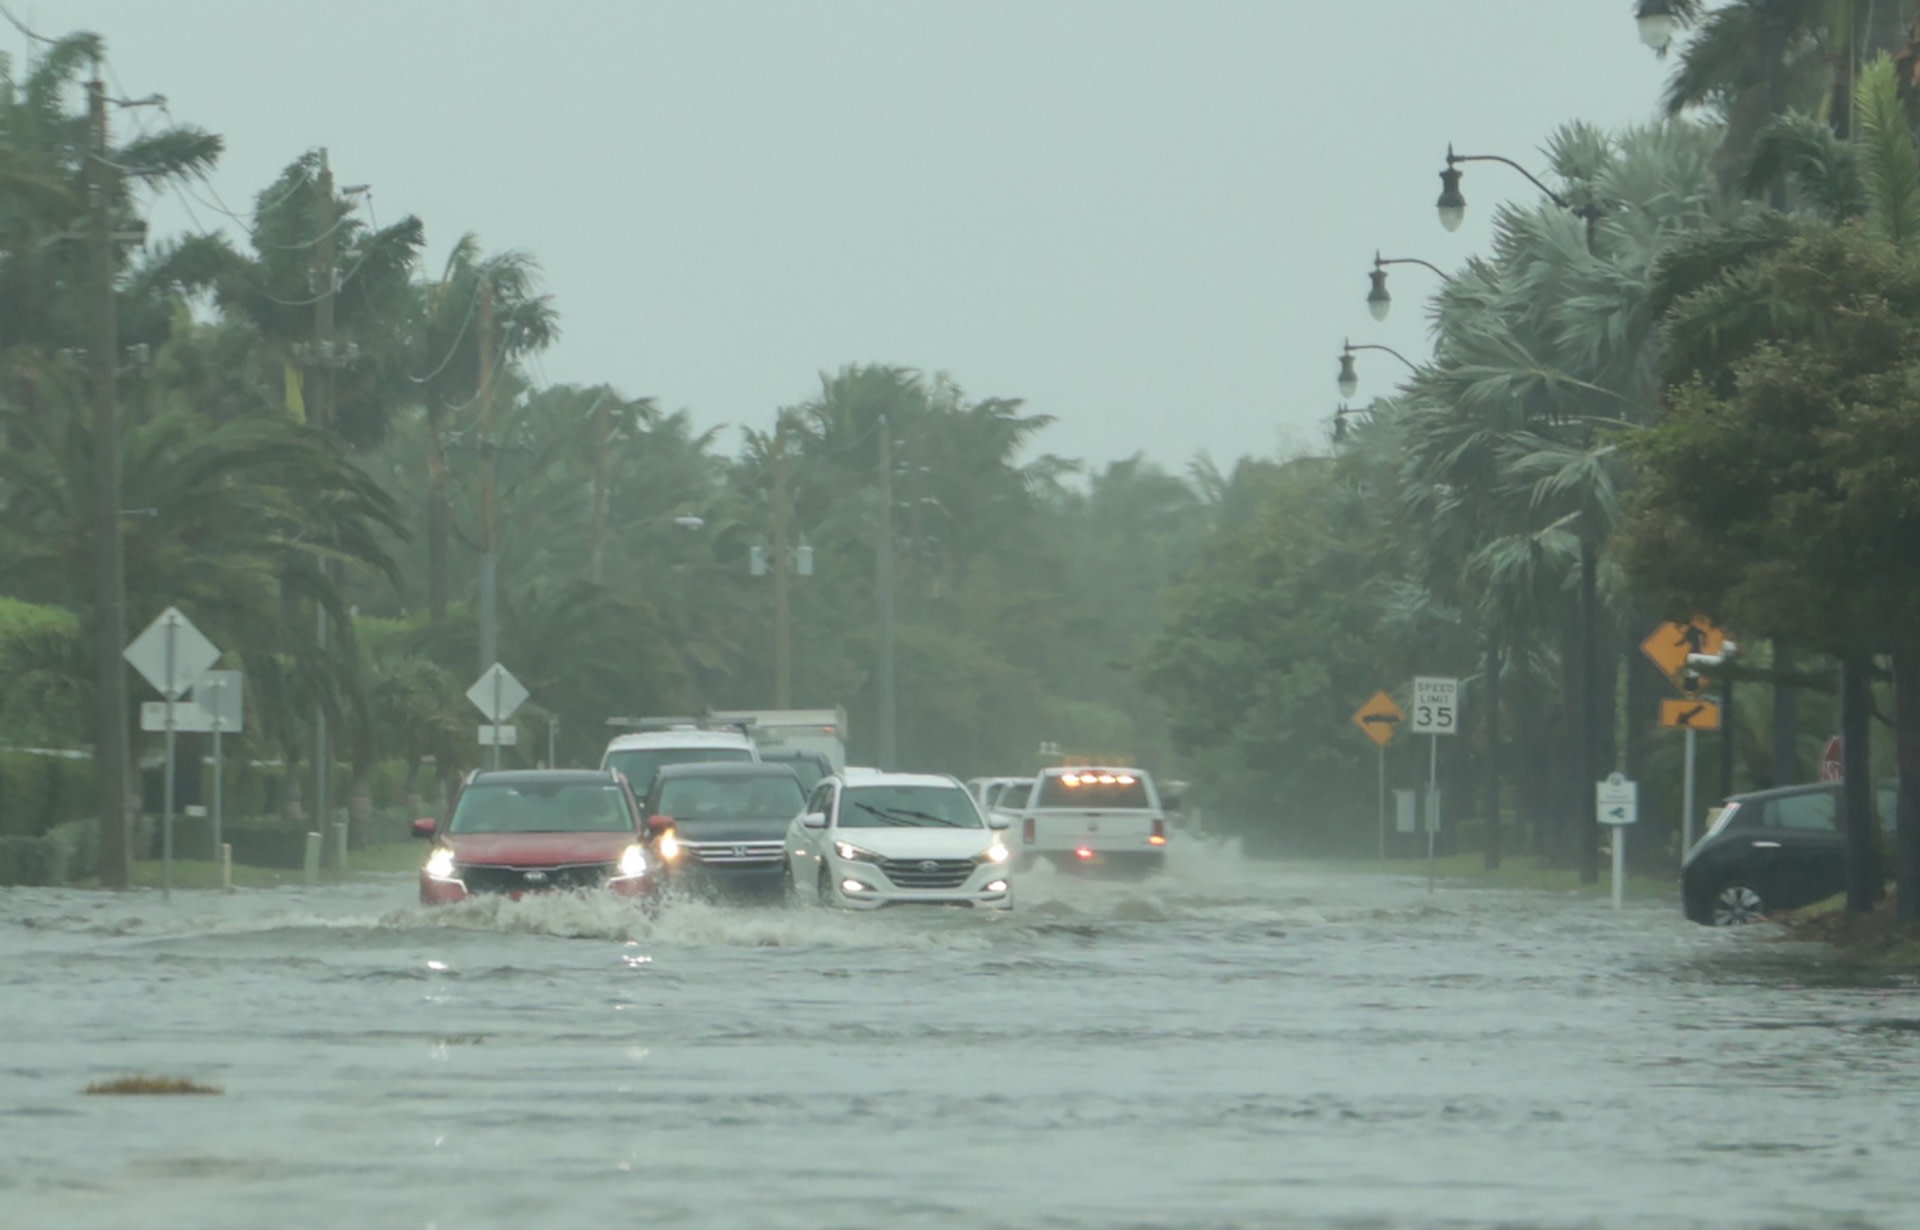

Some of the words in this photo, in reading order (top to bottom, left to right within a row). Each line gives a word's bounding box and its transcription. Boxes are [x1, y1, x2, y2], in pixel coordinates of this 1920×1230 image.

[1418, 682, 1455, 693] SPEED
[1420, 695, 1448, 704] LIMIT
[1417, 706, 1452, 727] 35
